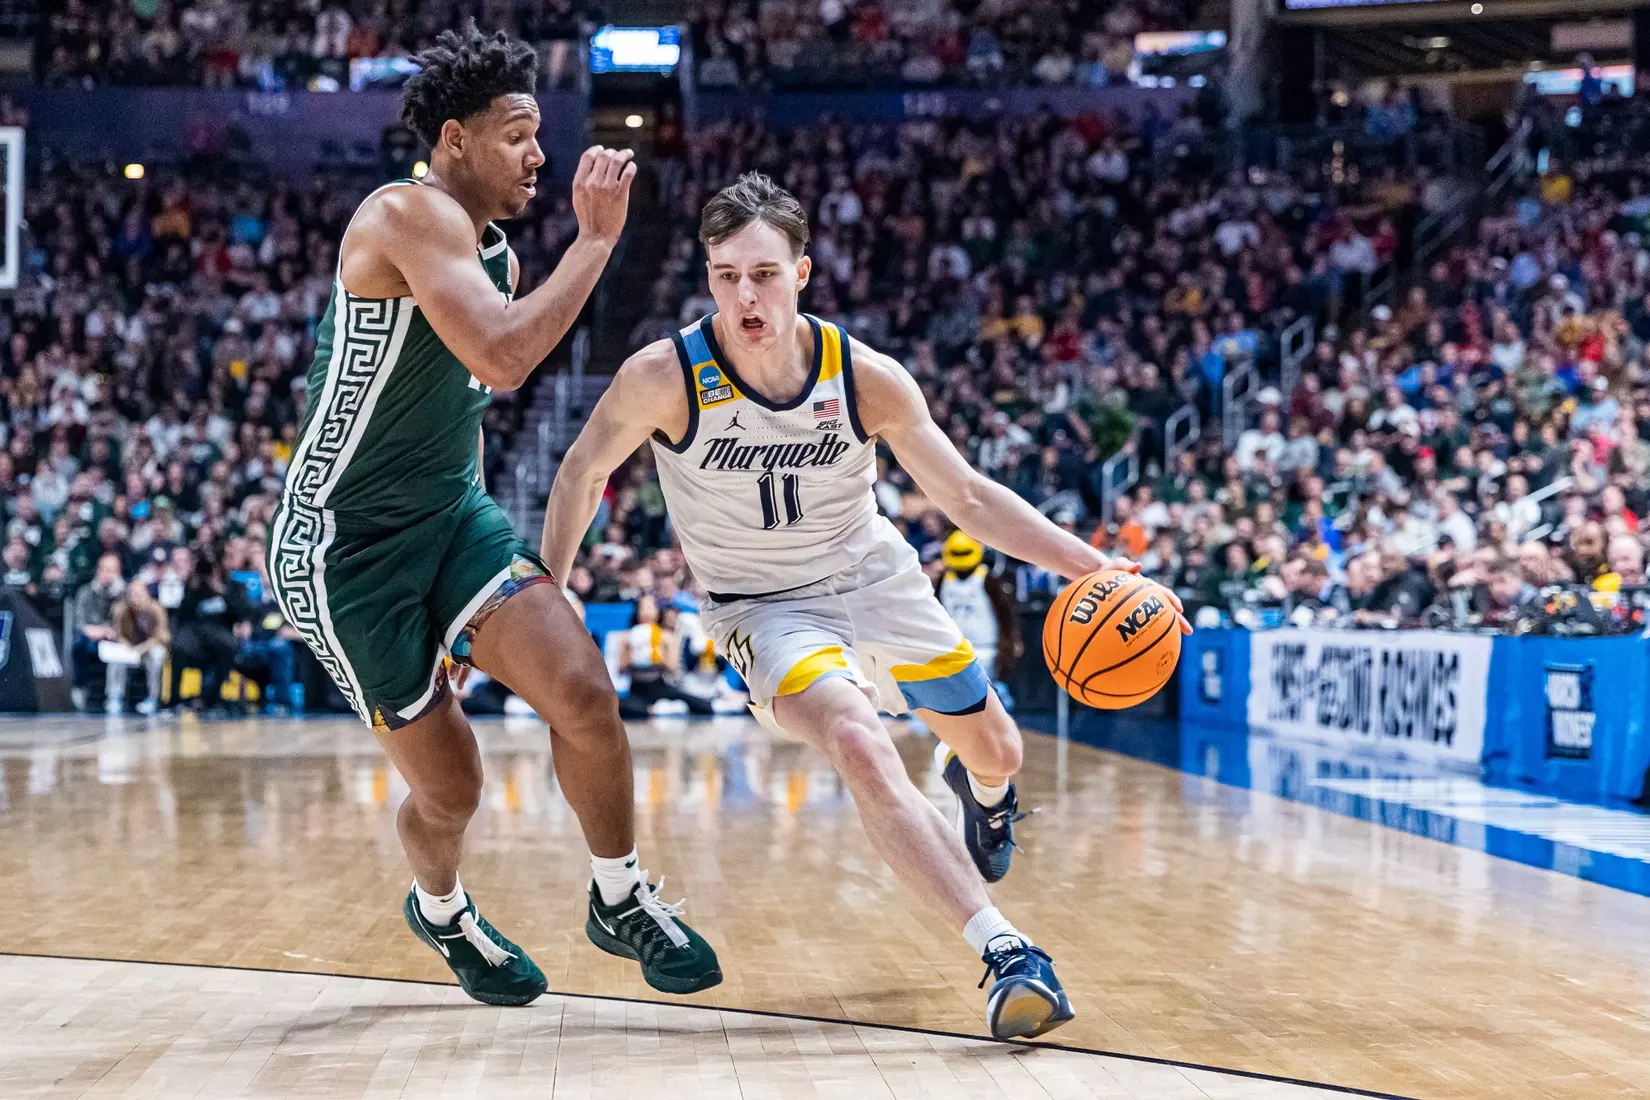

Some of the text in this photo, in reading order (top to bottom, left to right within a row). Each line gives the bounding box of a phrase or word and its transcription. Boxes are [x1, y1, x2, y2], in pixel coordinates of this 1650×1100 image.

[702, 375, 720, 384] NCAA
[702, 392, 733, 404] CHANGE
[815, 423, 844, 431] EAST
[699, 433, 850, 472] Marquette
[756, 471, 804, 530] 11
[1069, 573, 1129, 625] Wilso
[1115, 593, 1165, 643] NCAA
